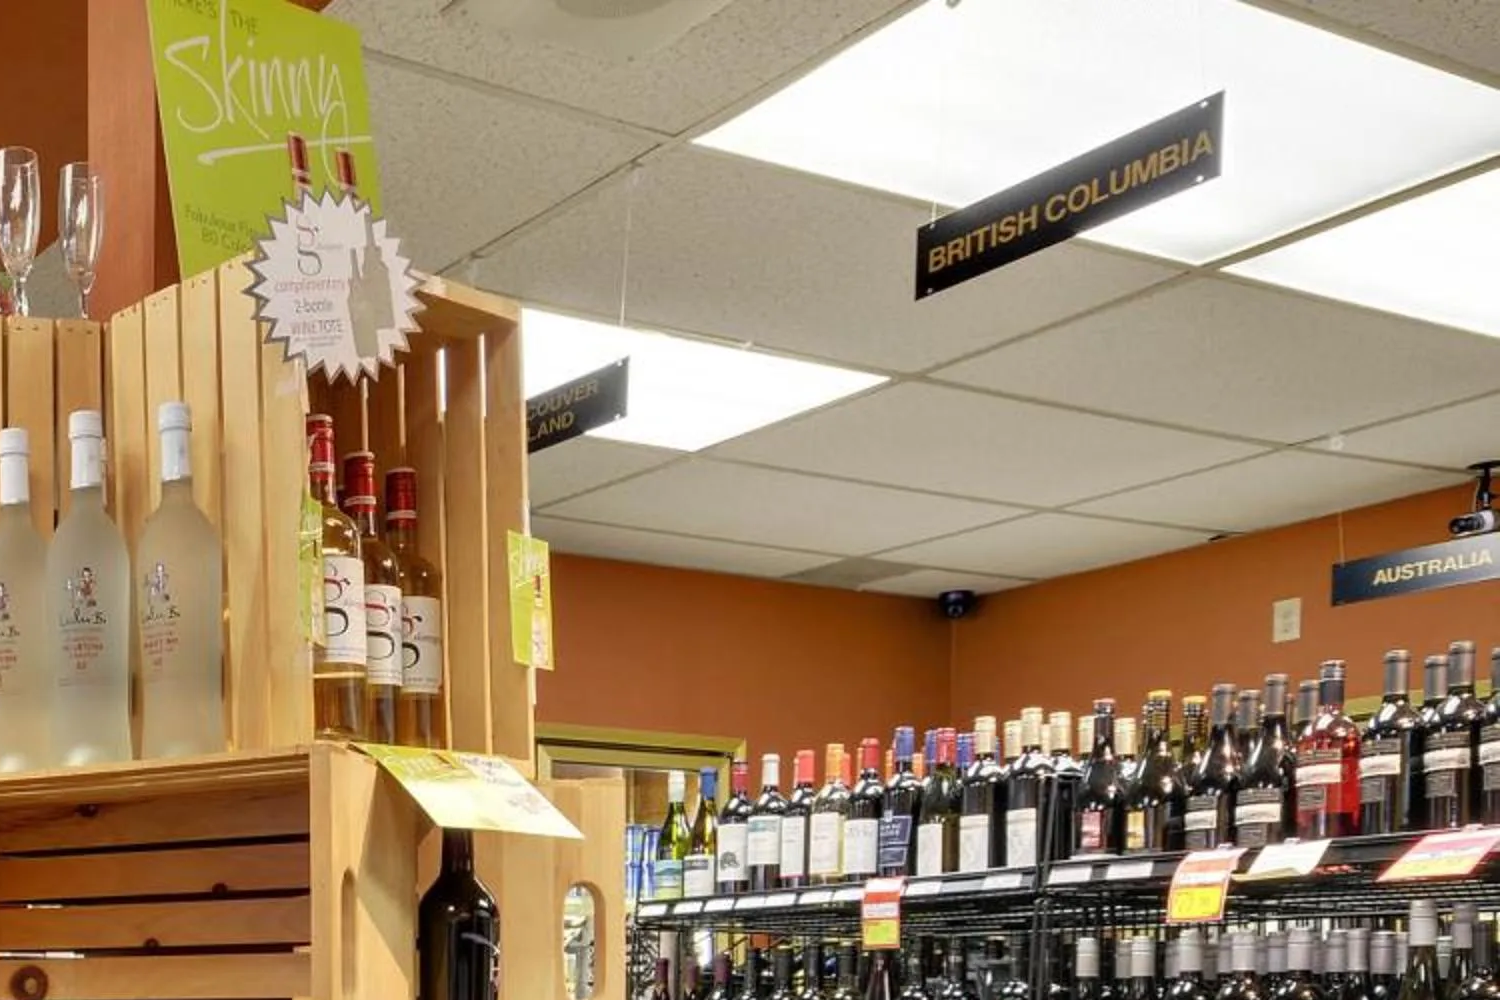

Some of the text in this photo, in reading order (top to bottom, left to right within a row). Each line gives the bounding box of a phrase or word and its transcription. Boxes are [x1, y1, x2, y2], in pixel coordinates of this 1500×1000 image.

[164, 0, 350, 188] Skinny
[928, 131, 1214, 273] BRITISH COLUMBIA
[527, 380, 598, 420] COUVER
[528, 410, 575, 441] LAND
[1373, 548, 1493, 586] AUSTRALIA
